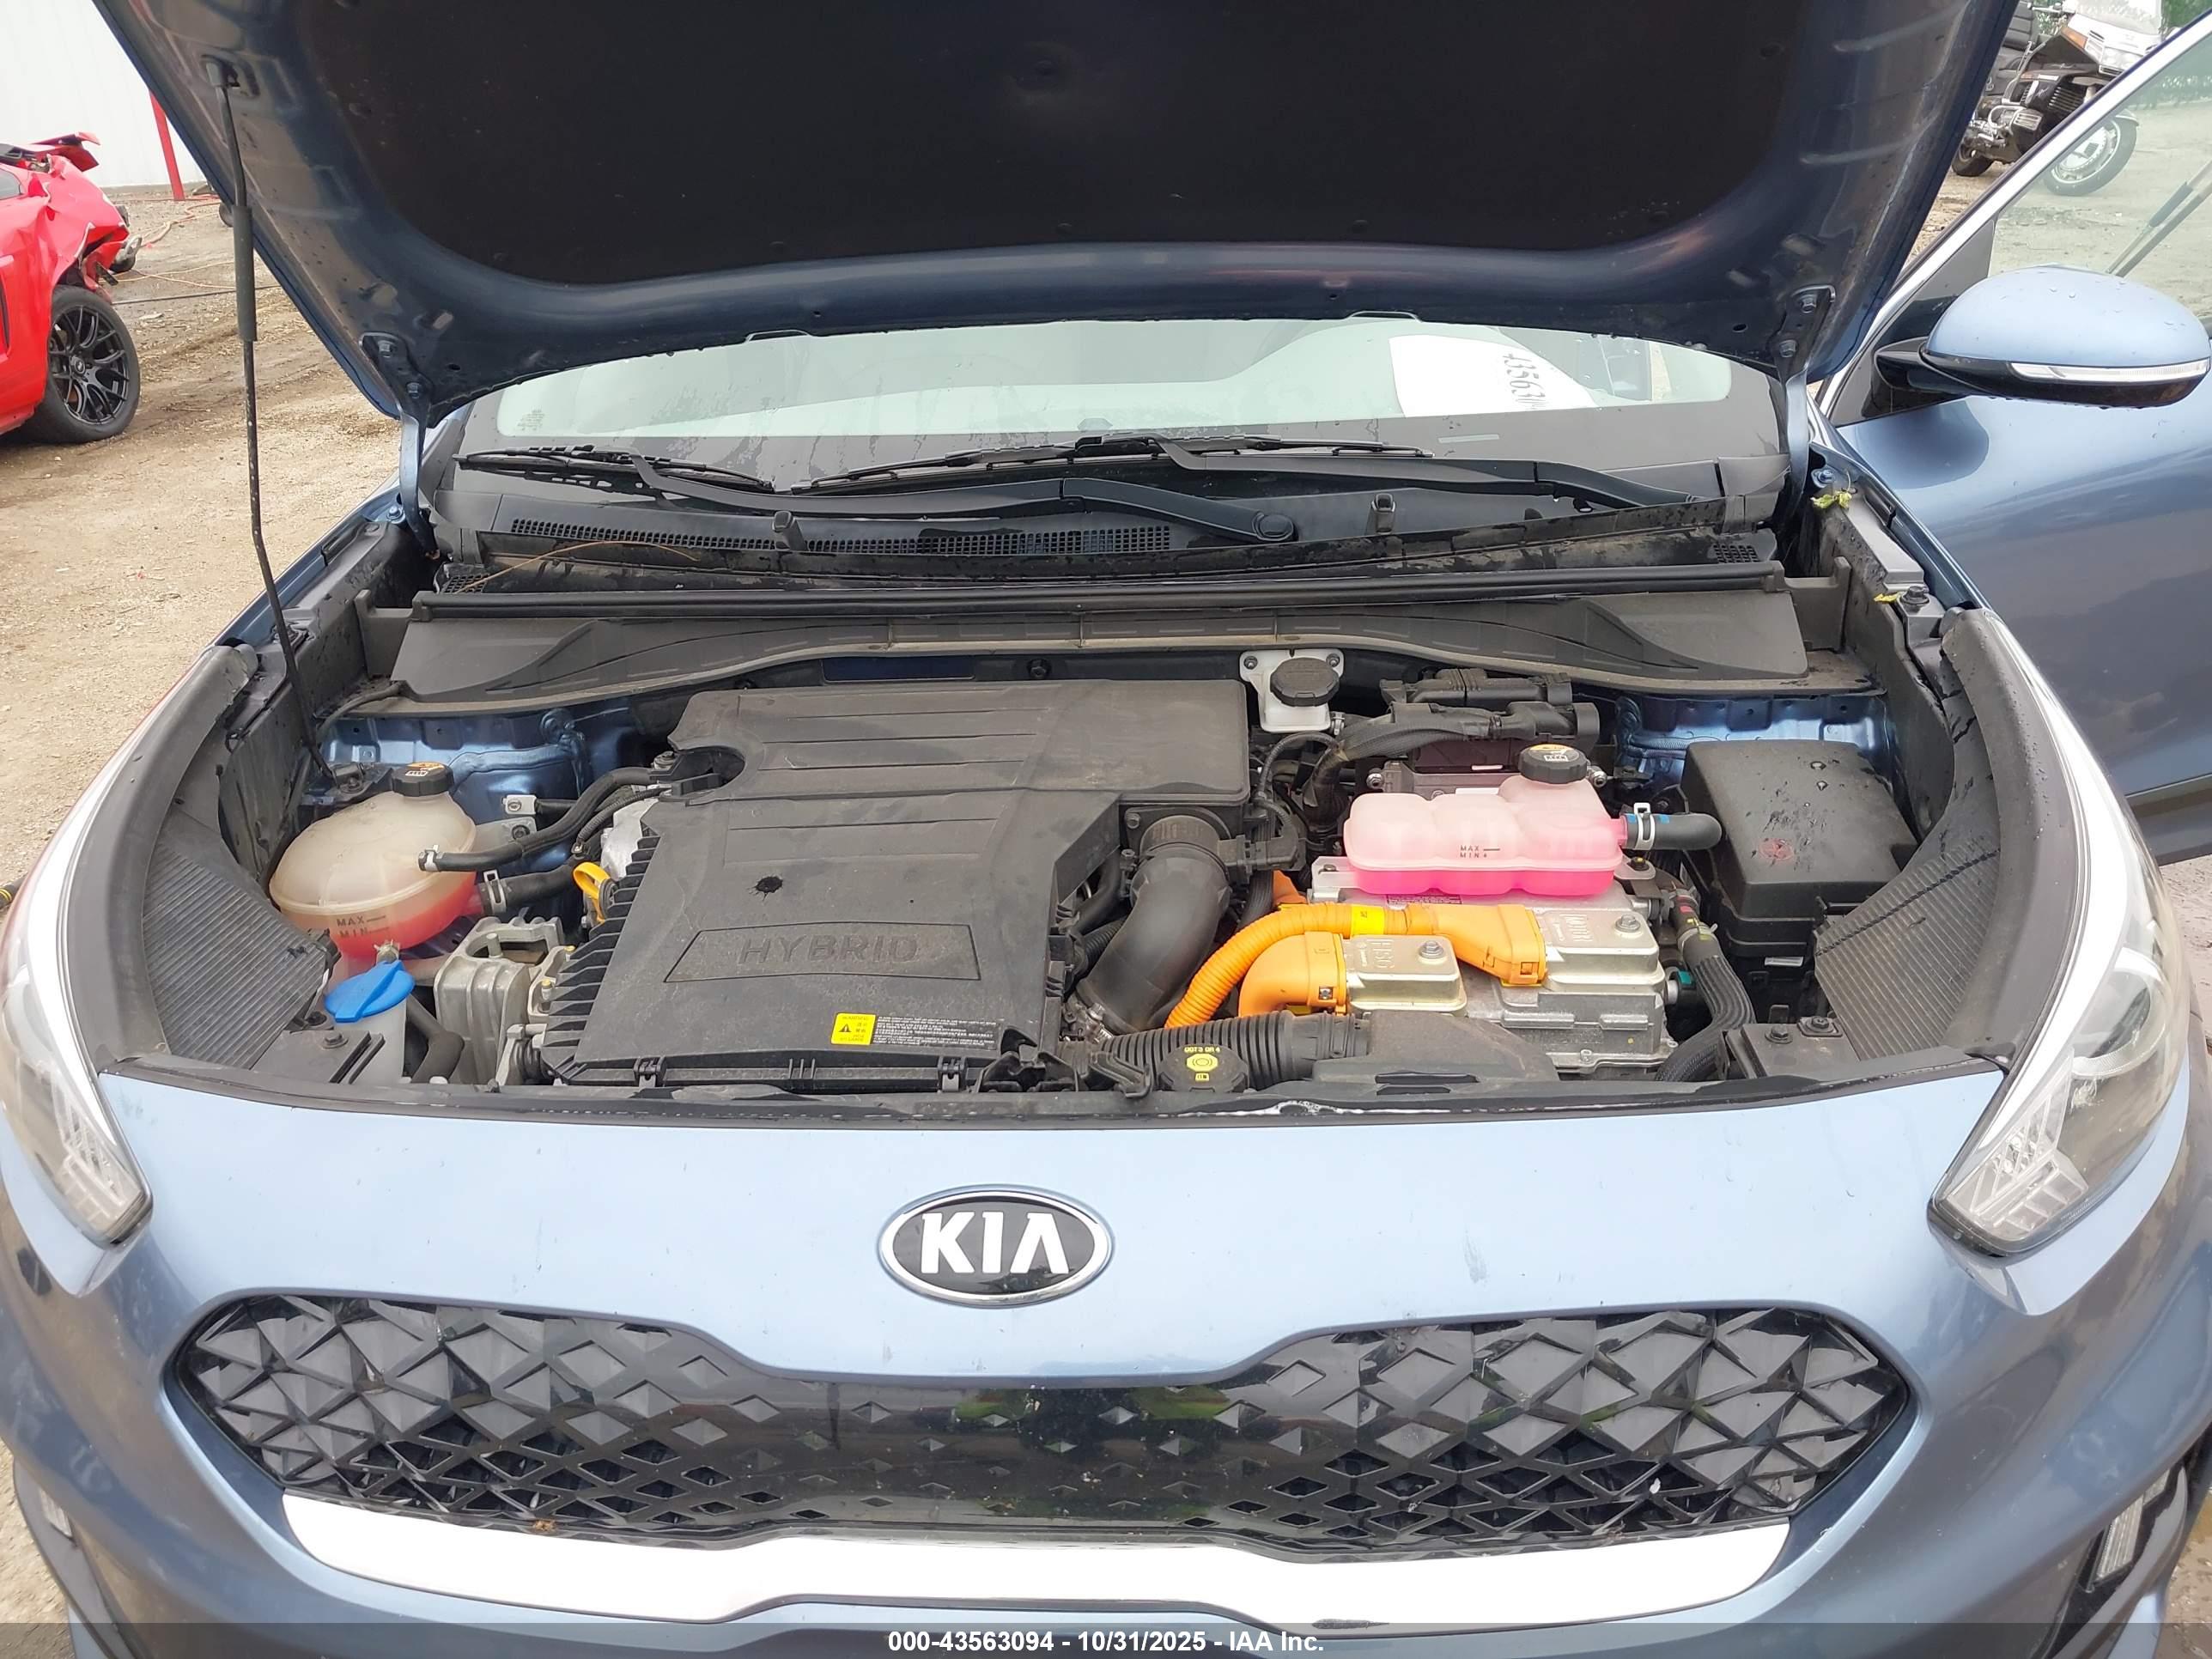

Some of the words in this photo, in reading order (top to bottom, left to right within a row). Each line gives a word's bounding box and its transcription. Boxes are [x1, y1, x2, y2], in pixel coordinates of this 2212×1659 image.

[337, 915, 364, 927] MAX
[339, 927, 368, 938] MIN
[736, 933, 921, 964] HYBRID
[921, 1211, 1069, 1274] KIA
